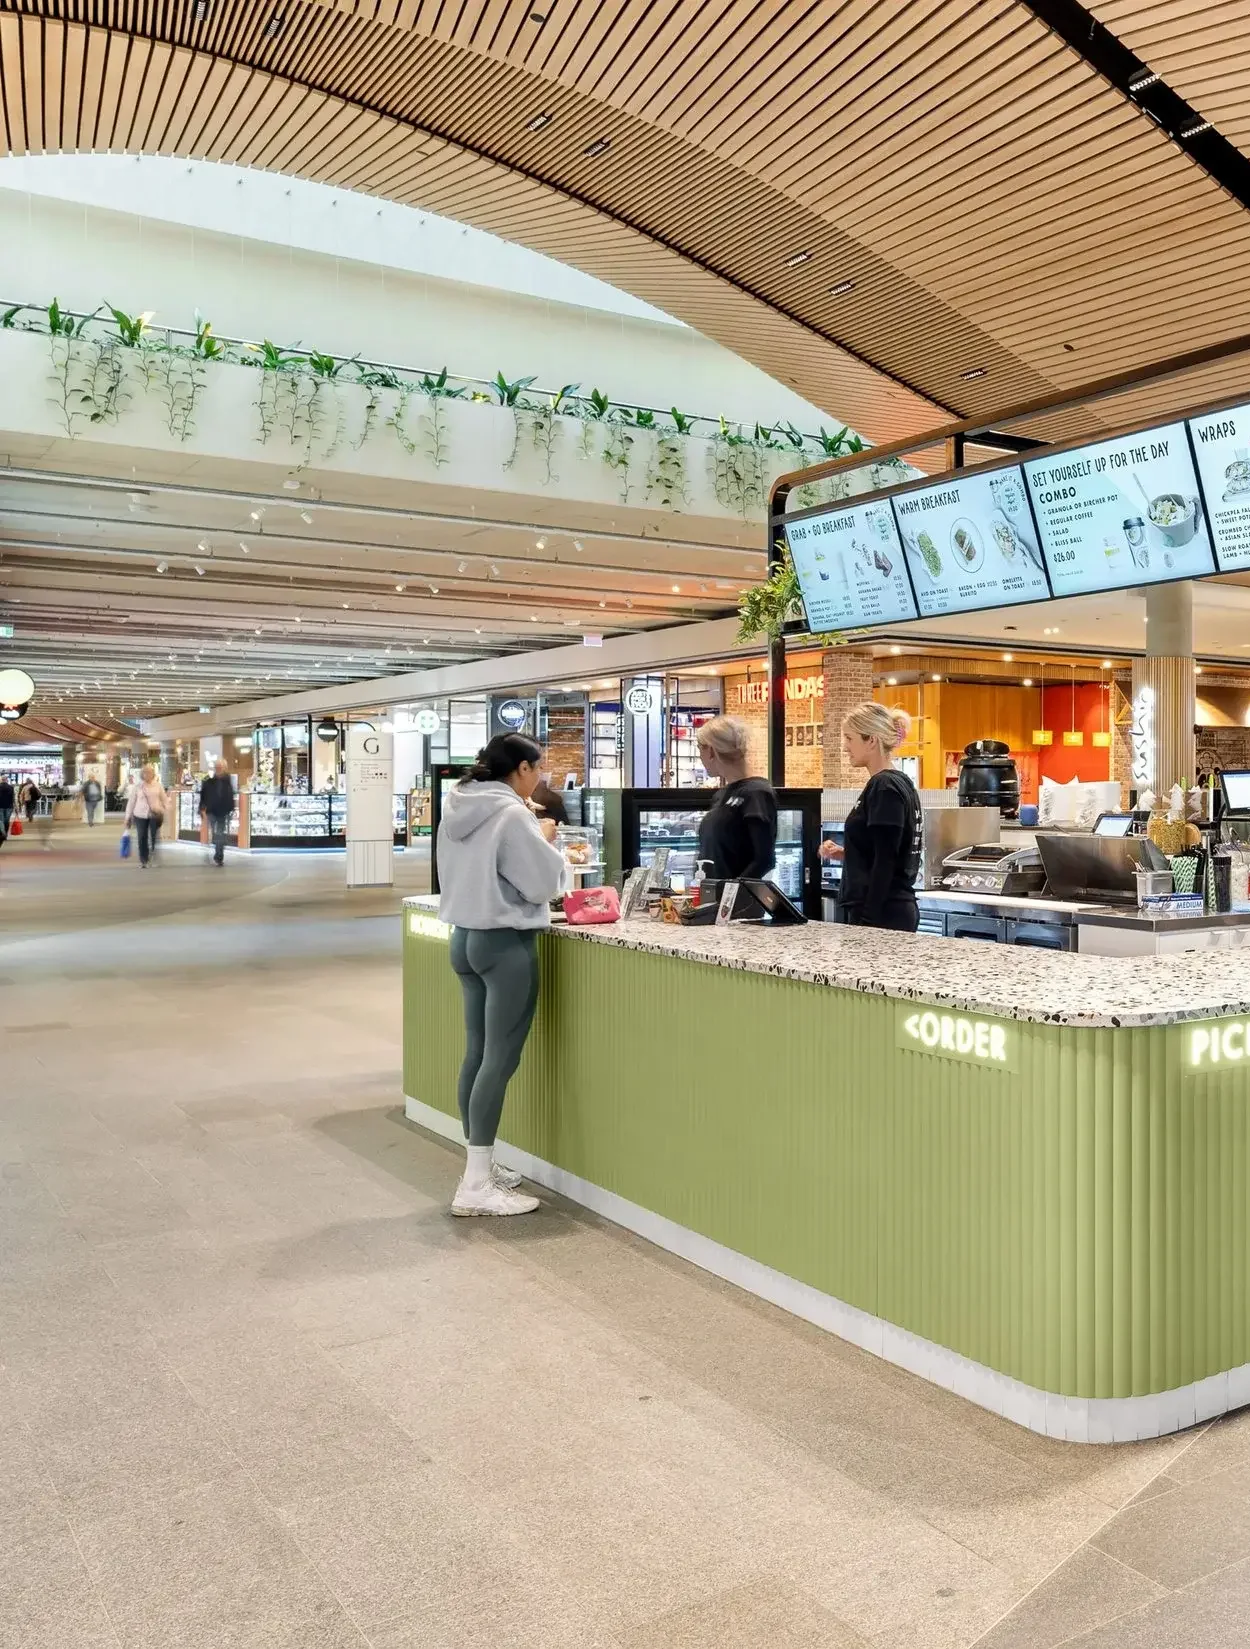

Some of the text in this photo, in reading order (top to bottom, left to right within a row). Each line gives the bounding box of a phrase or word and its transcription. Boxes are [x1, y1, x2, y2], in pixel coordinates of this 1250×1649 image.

[1198, 420, 1236, 443] WRAPS
[1033, 441, 1170, 487] SET YOURSELF UP FOR THE DAY
[898, 489, 960, 515] WARM BREAKFAST
[1040, 487, 1076, 504] COMBO
[1048, 505, 1073, 515] GRANOLA
[1084, 497, 1106, 507] BIRCHER
[1215, 509, 1240, 518] CHICKPEA
[1050, 512, 1093, 525] REGULAR COFFEE
[790, 527, 806, 540] GRAB
[812, 524, 821, 535] GO
[821, 515, 855, 533] BREAKFAST
[1053, 528, 1069, 536] SALAD
[1219, 527, 1242, 535] CRUMBED
[1054, 550, 1076, 562] $26.00
[1177, 901, 1202, 909] MEDIUM
